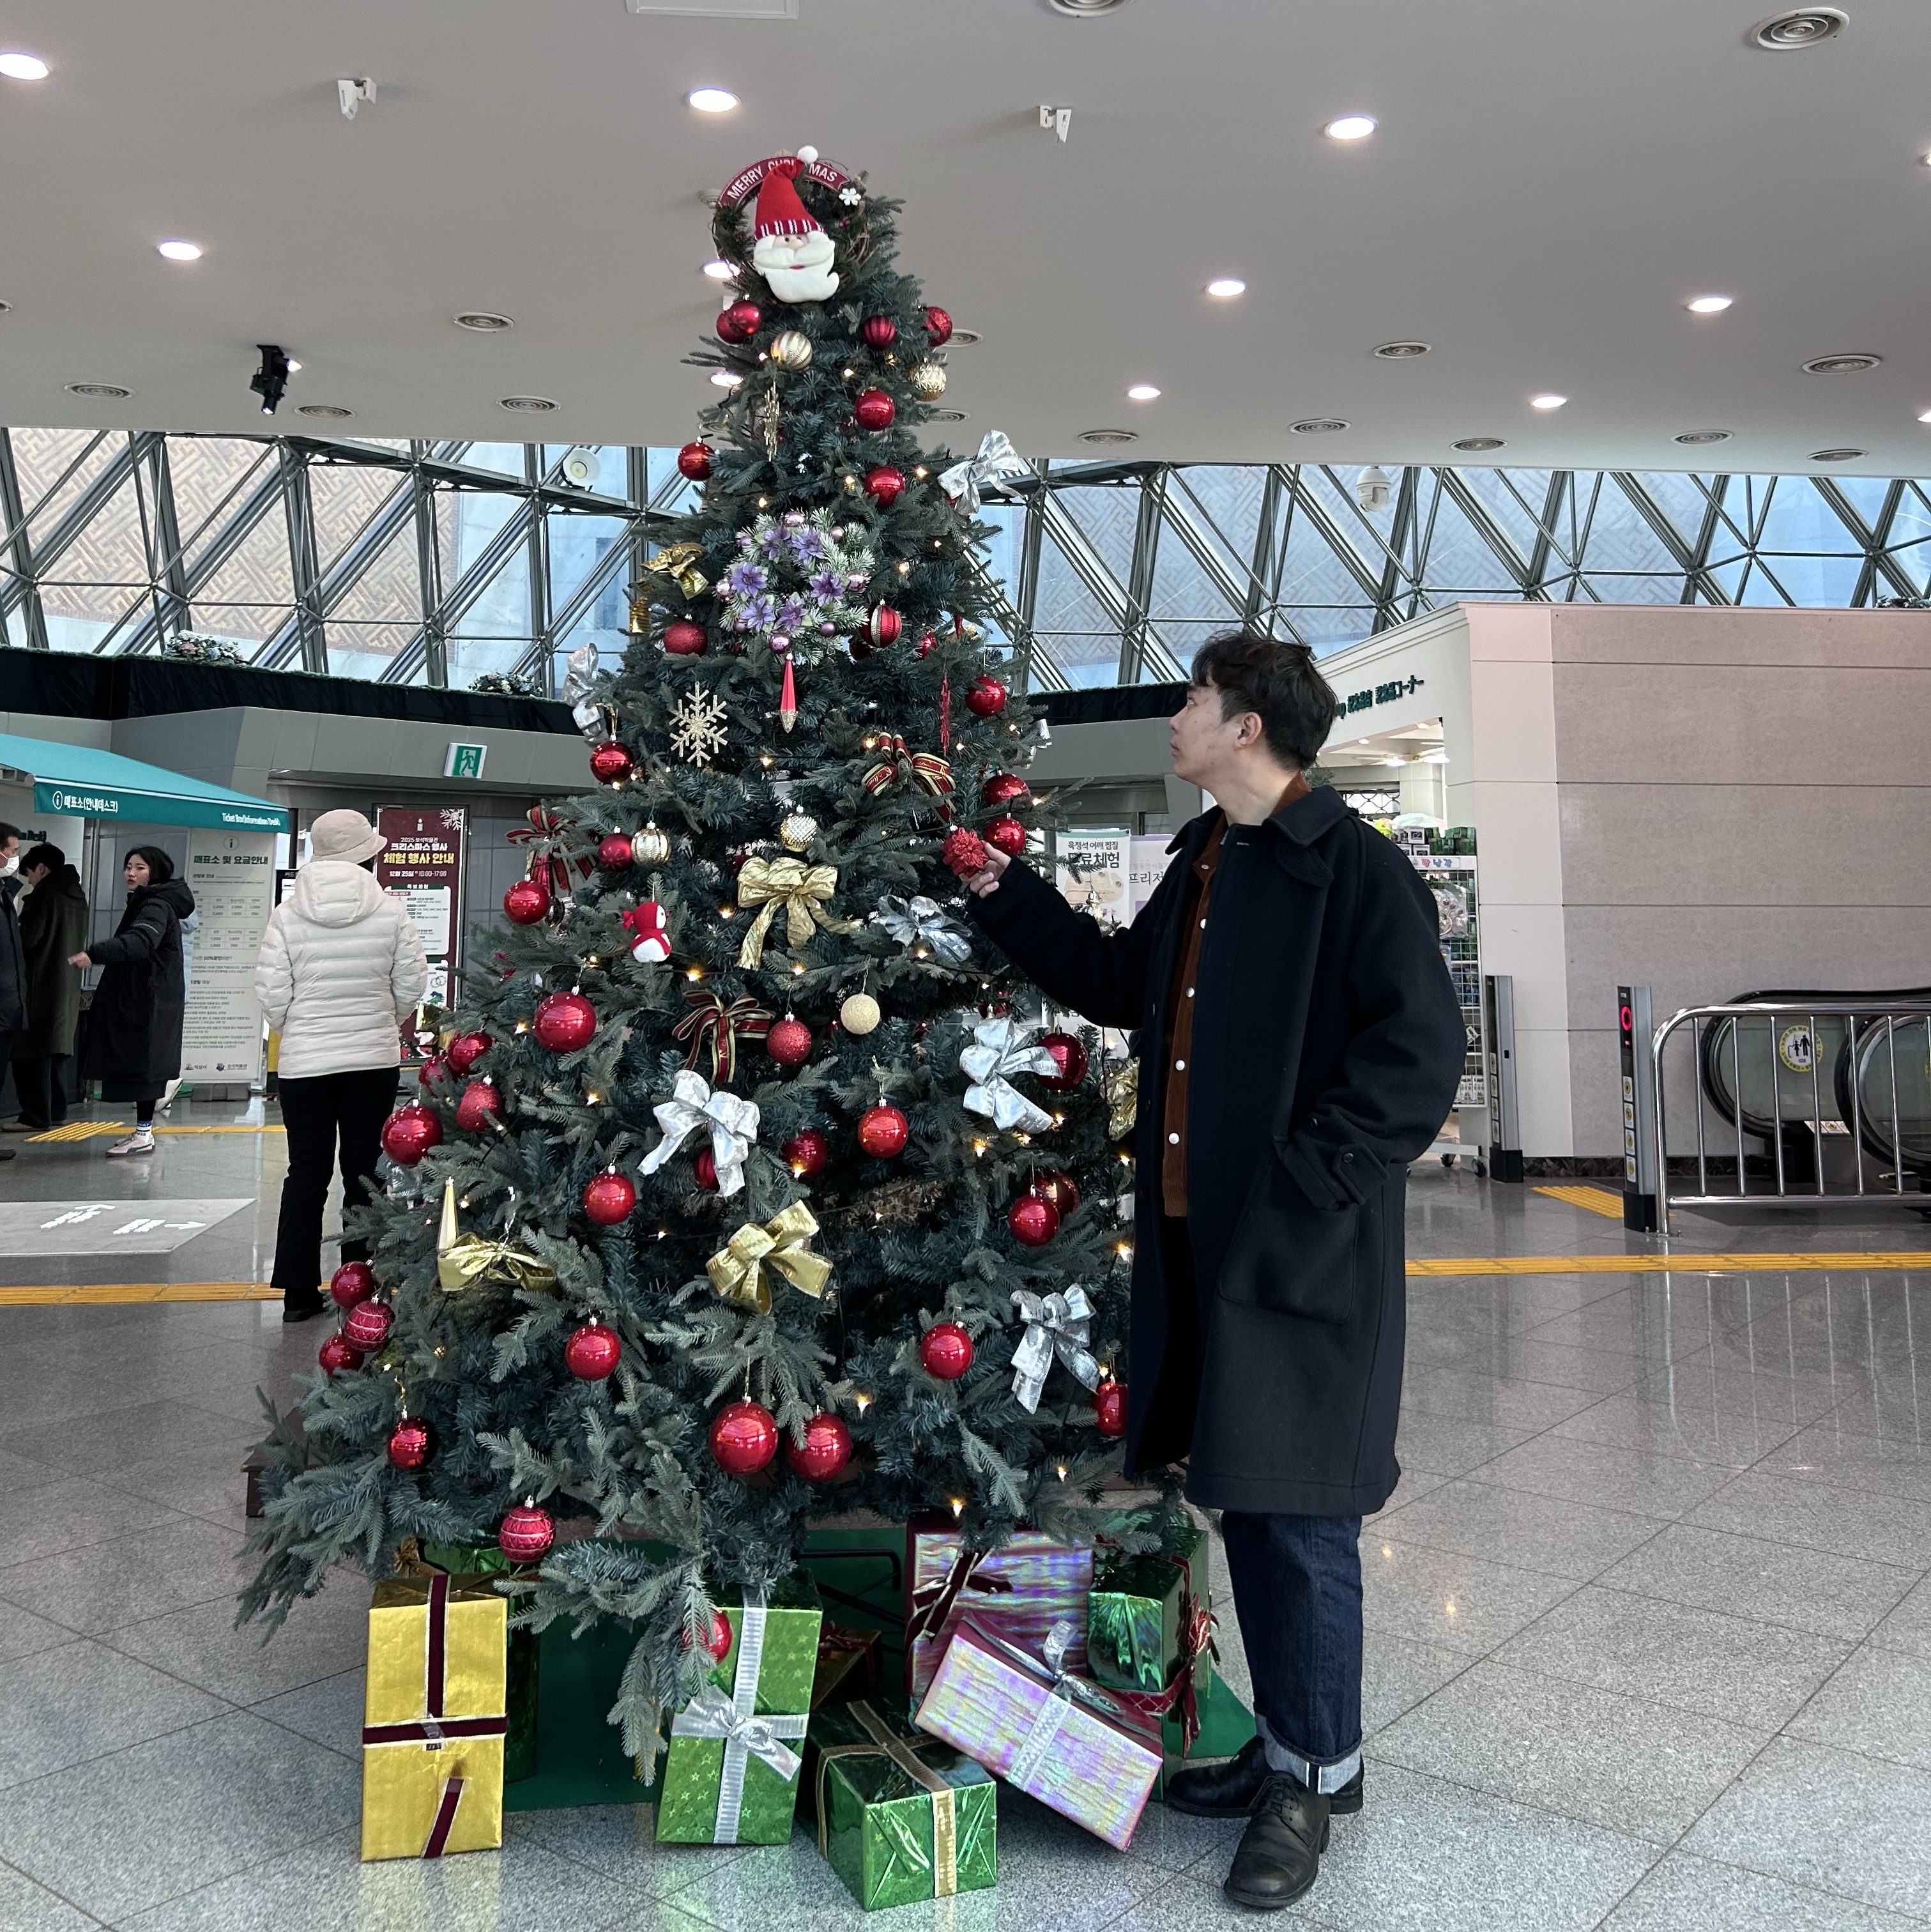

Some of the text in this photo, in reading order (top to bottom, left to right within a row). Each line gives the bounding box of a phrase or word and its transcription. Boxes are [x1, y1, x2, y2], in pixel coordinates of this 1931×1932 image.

[727, 165, 764, 201] MERRY
[390, 843, 448, 851] 크리스마스 행사
[1089, 841, 1104, 850] 어깨
[1104, 841, 1118, 850] 찜질
[194, 855, 220, 864] 매표소
[233, 856, 268, 865] 요금안내
[383, 852, 455, 864] 체험 행사 안내
